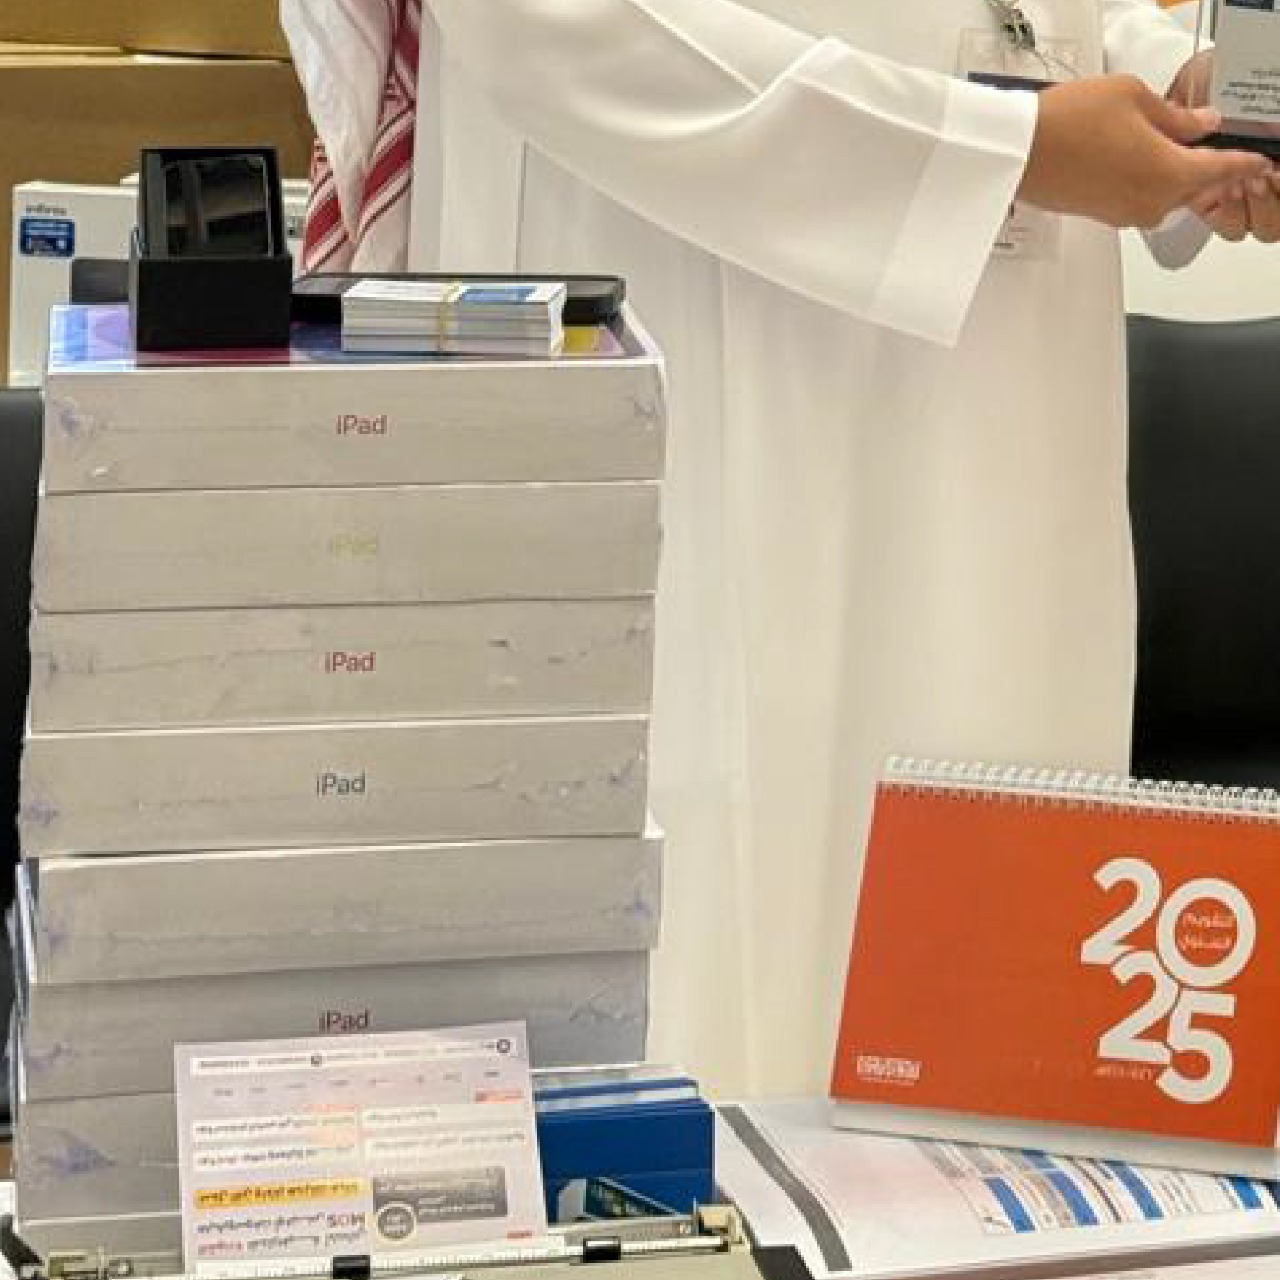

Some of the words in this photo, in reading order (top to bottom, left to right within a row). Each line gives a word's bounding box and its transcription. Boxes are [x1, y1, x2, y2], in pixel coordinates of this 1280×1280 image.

[335, 414, 389, 436] iPad
[323, 650, 377, 673] iPad
[316, 770, 367, 797] iPad
[319, 1009, 370, 1033] iPad
